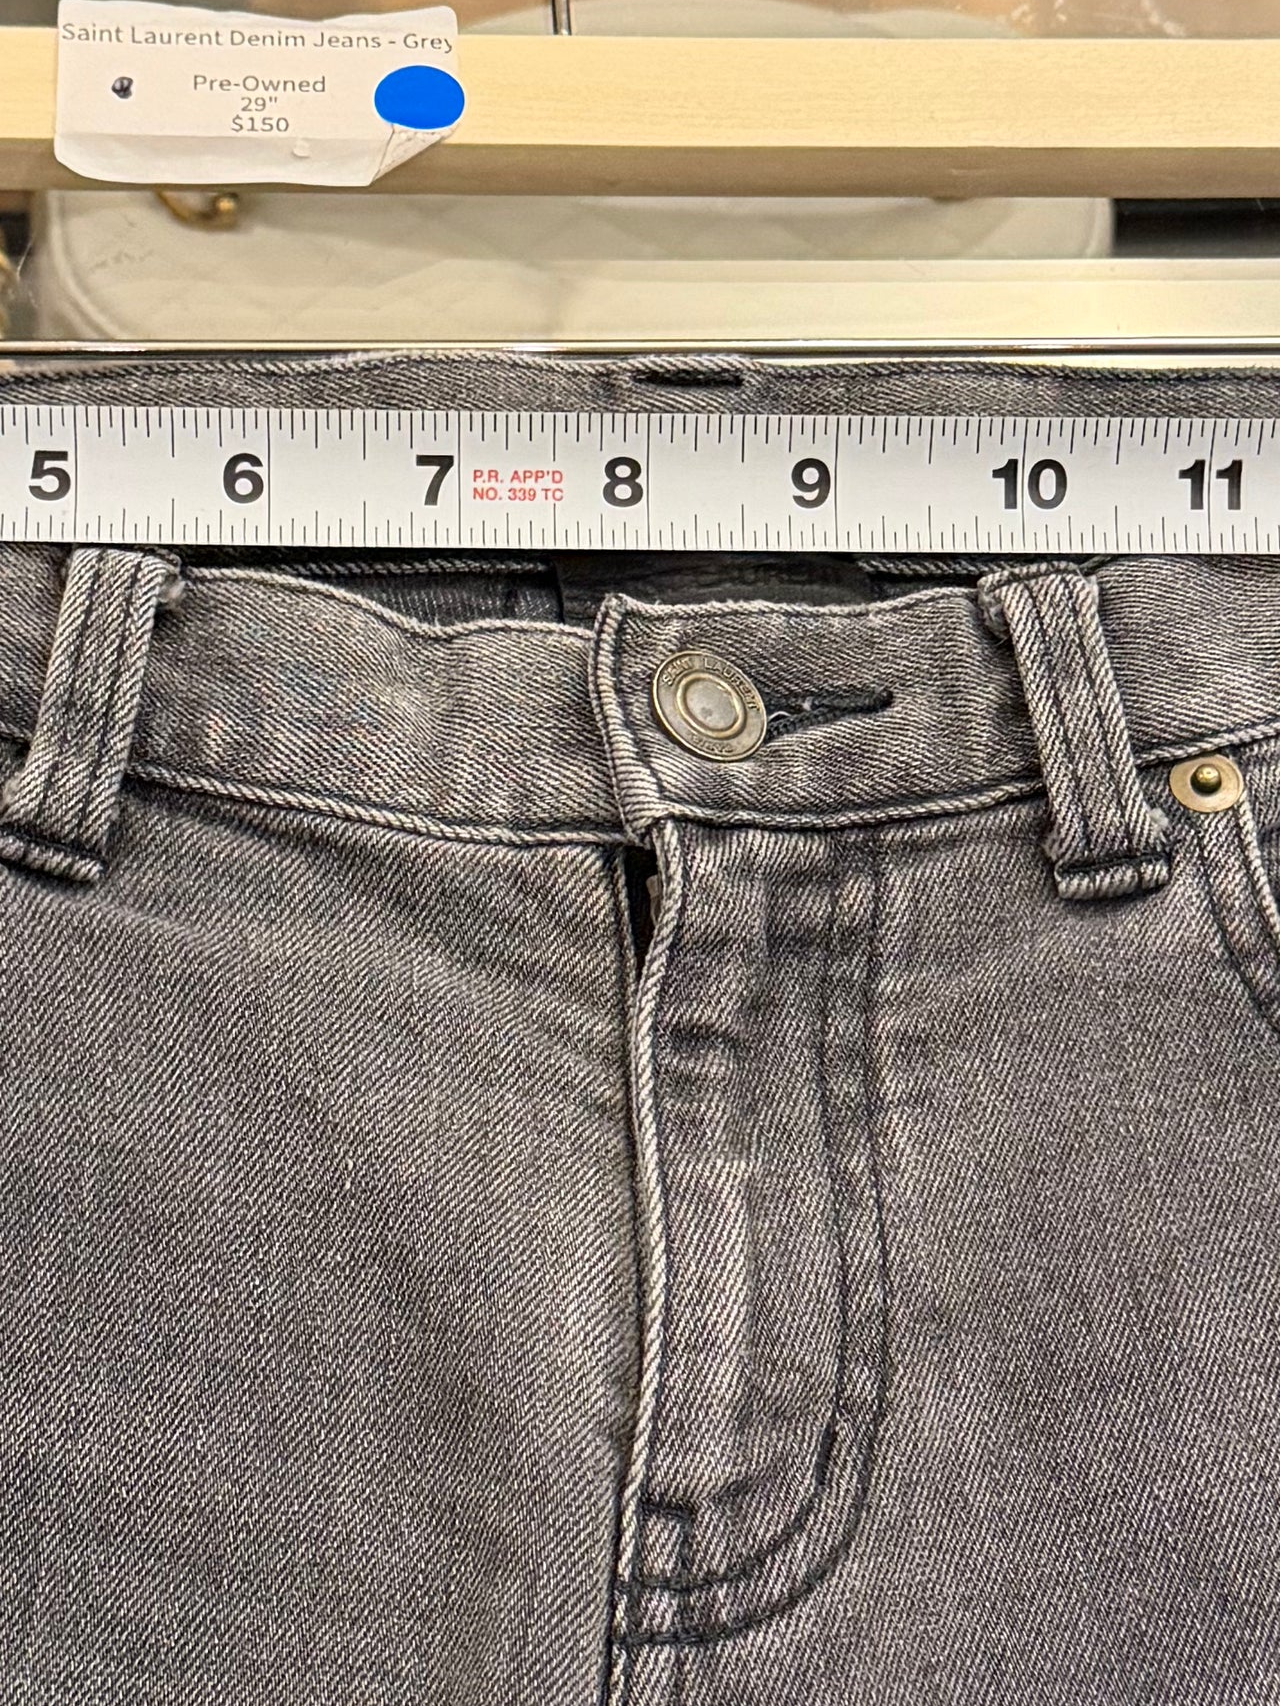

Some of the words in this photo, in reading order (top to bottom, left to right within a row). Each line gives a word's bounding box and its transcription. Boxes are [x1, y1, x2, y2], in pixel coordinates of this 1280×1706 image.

[61, 23, 124, 44] Saint
[131, 25, 224, 47] Laurent
[230, 30, 306, 49] Denim
[313, 31, 382, 50] Jeans
[403, 33, 453, 54] Grey
[192, 74, 327, 94] Pre-Owned
[240, 96, 279, 113] 29"
[231, 114, 290, 133] $150
[28, 450, 72, 501] 5
[222, 452, 265, 505] 6
[414, 454, 455, 507] 7
[472, 486, 503, 502] NO.
[507, 486, 537, 502] 339
[541, 486, 564, 502] TC
[510, 468, 564, 485] APP'D
[601, 456, 644, 508] 8
[791, 457, 832, 510] 9
[991, 458, 1068, 510] 10
[1178, 459, 1243, 511] 11
